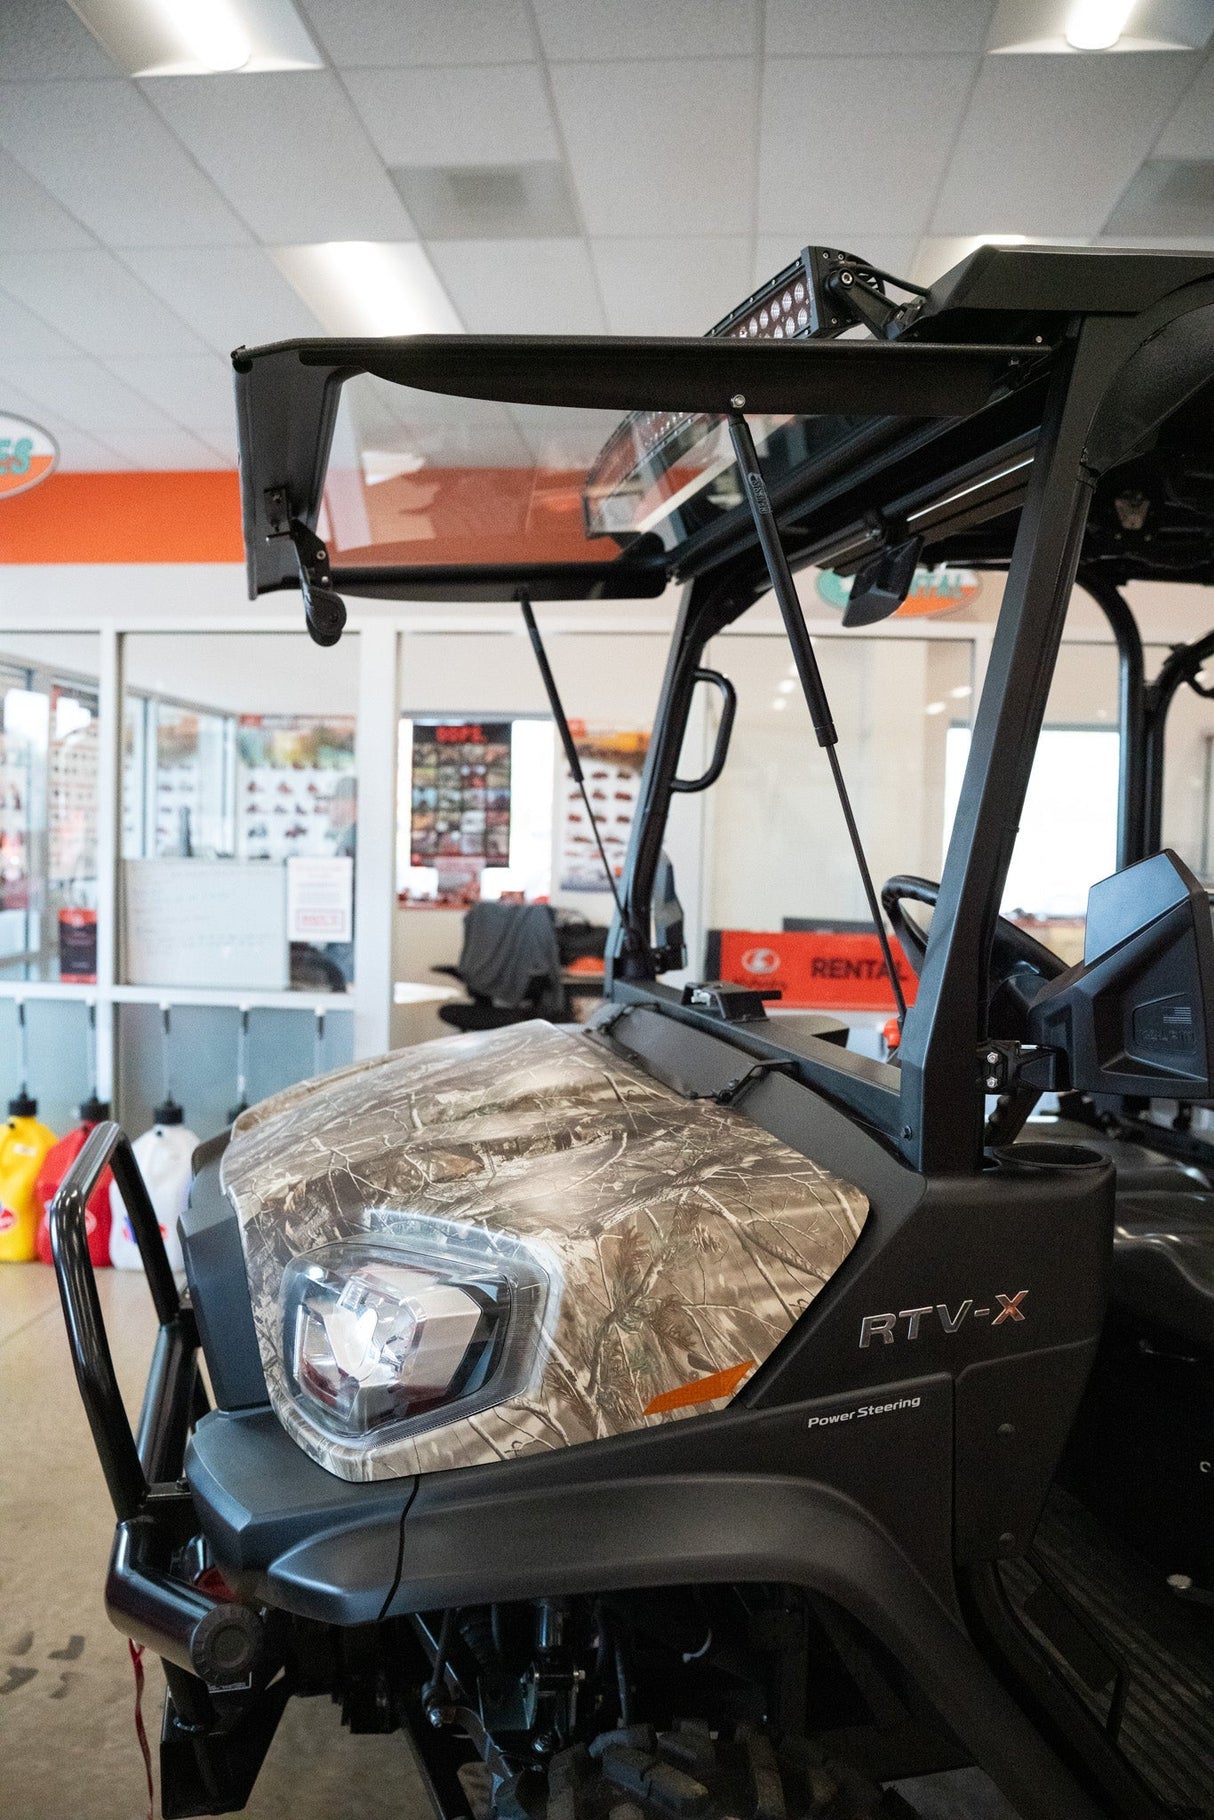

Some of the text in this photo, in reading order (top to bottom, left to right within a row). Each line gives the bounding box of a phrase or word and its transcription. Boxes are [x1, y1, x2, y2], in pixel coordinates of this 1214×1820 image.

[858, 1290, 1030, 1349] RTV-X
[808, 1397, 921, 1429] Power Steering
